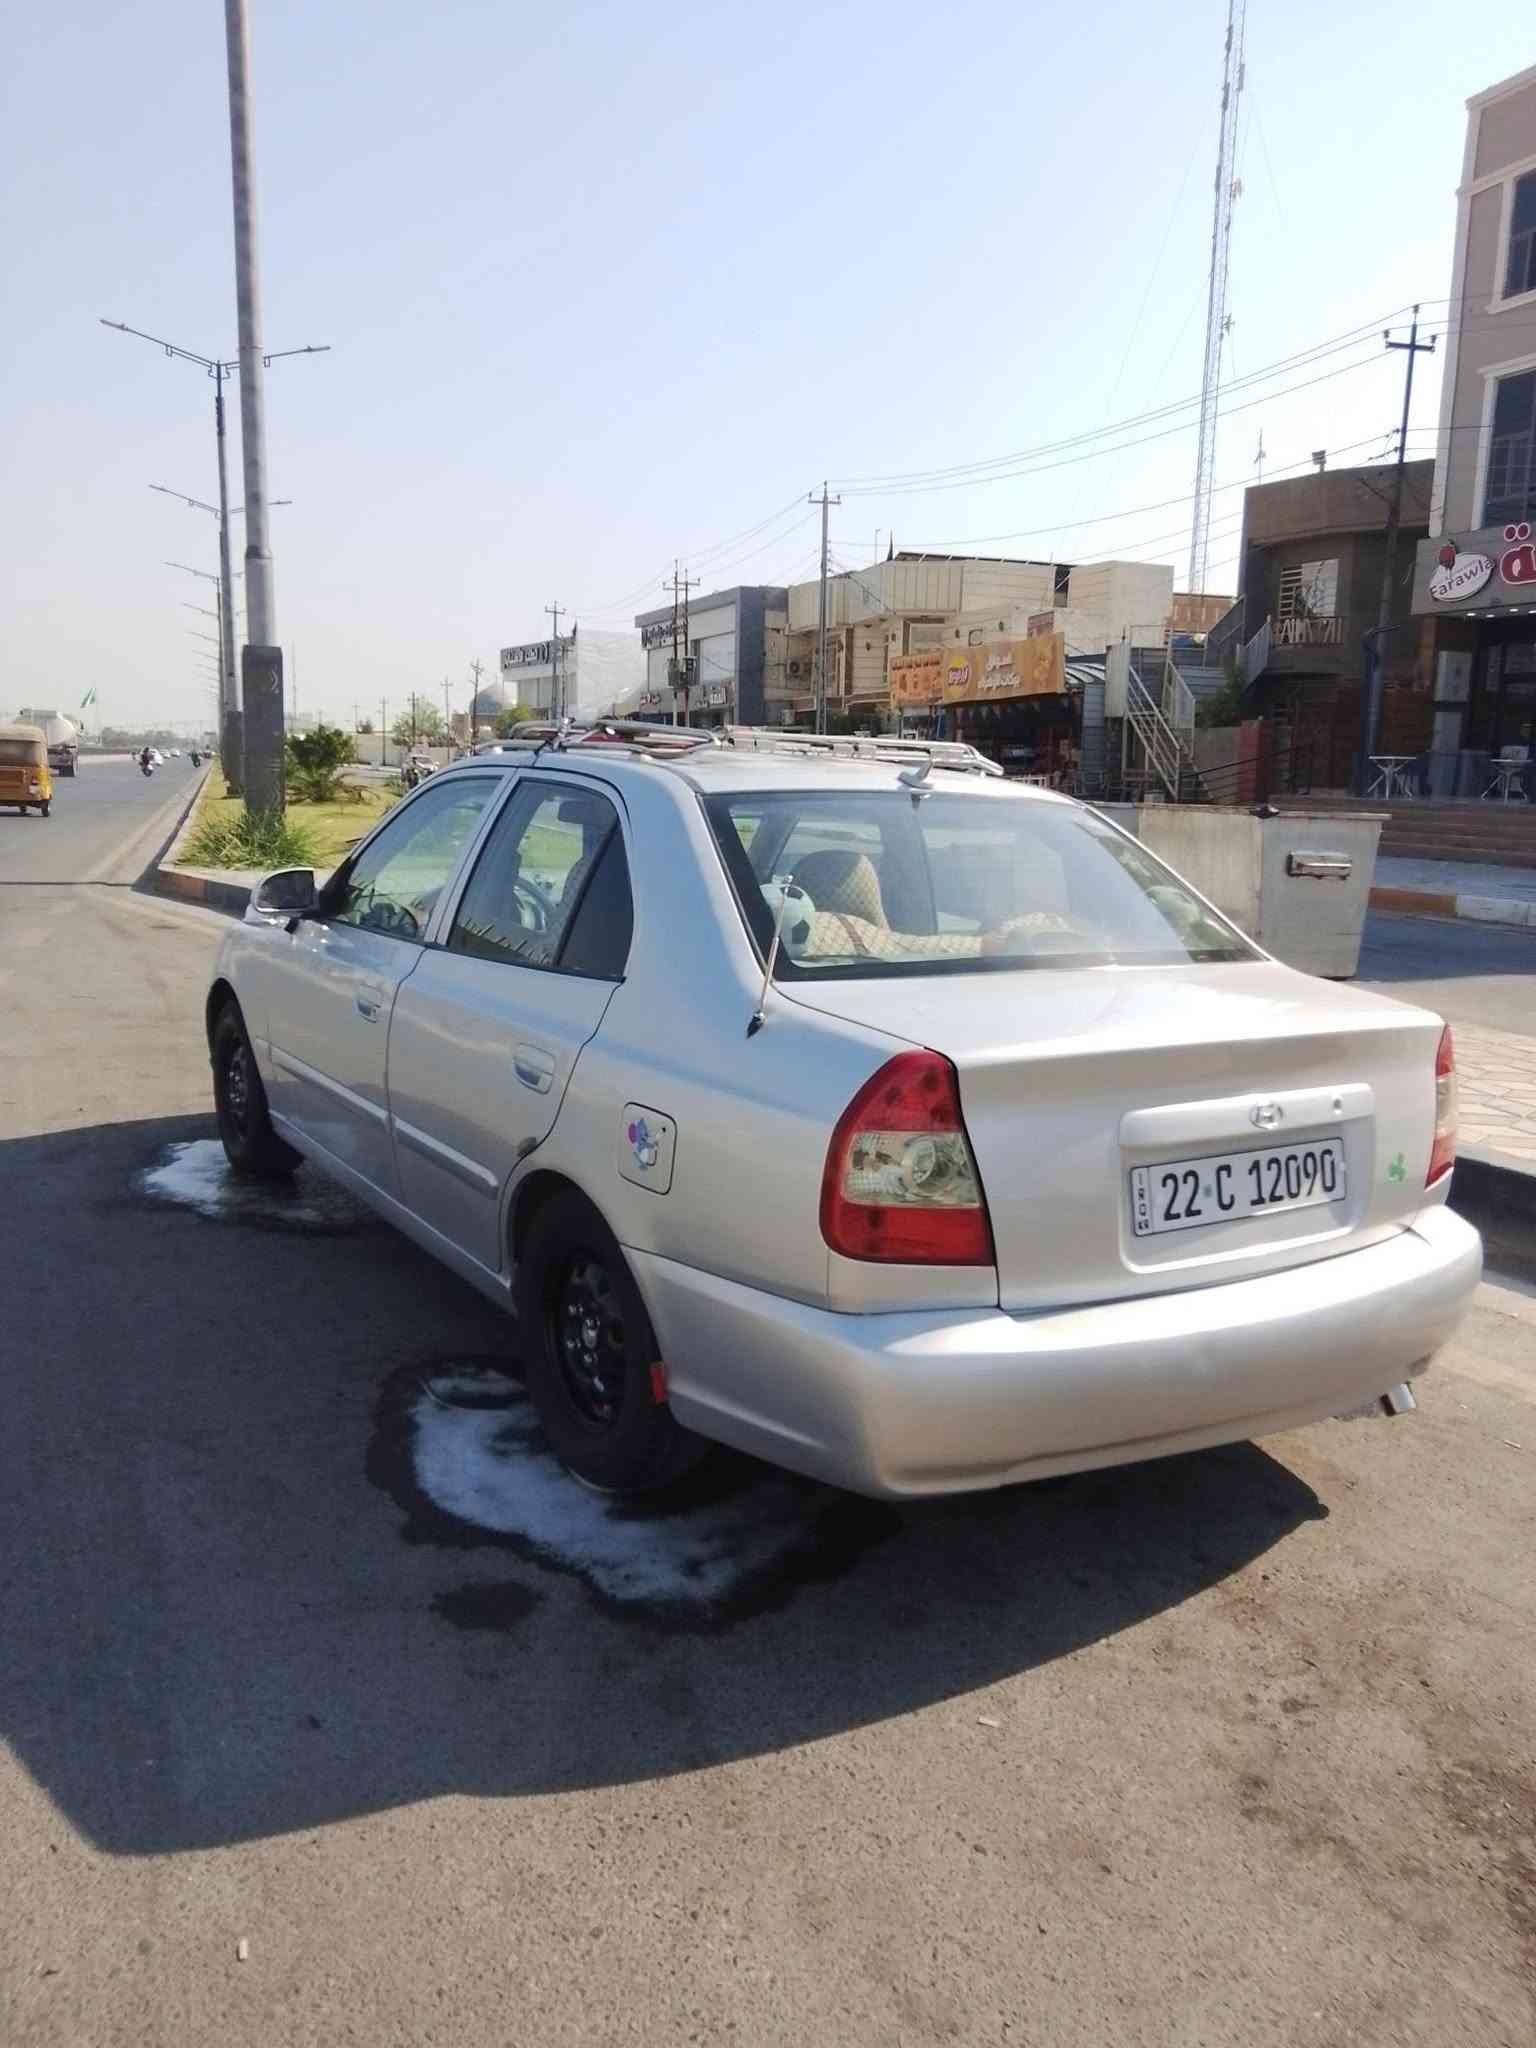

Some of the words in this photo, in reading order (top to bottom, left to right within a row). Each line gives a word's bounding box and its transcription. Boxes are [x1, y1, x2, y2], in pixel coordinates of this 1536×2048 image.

[1161, 1170, 1202, 1221] 22
[1215, 1164, 1235, 1211] C
[1248, 1149, 1336, 1206] 12090
